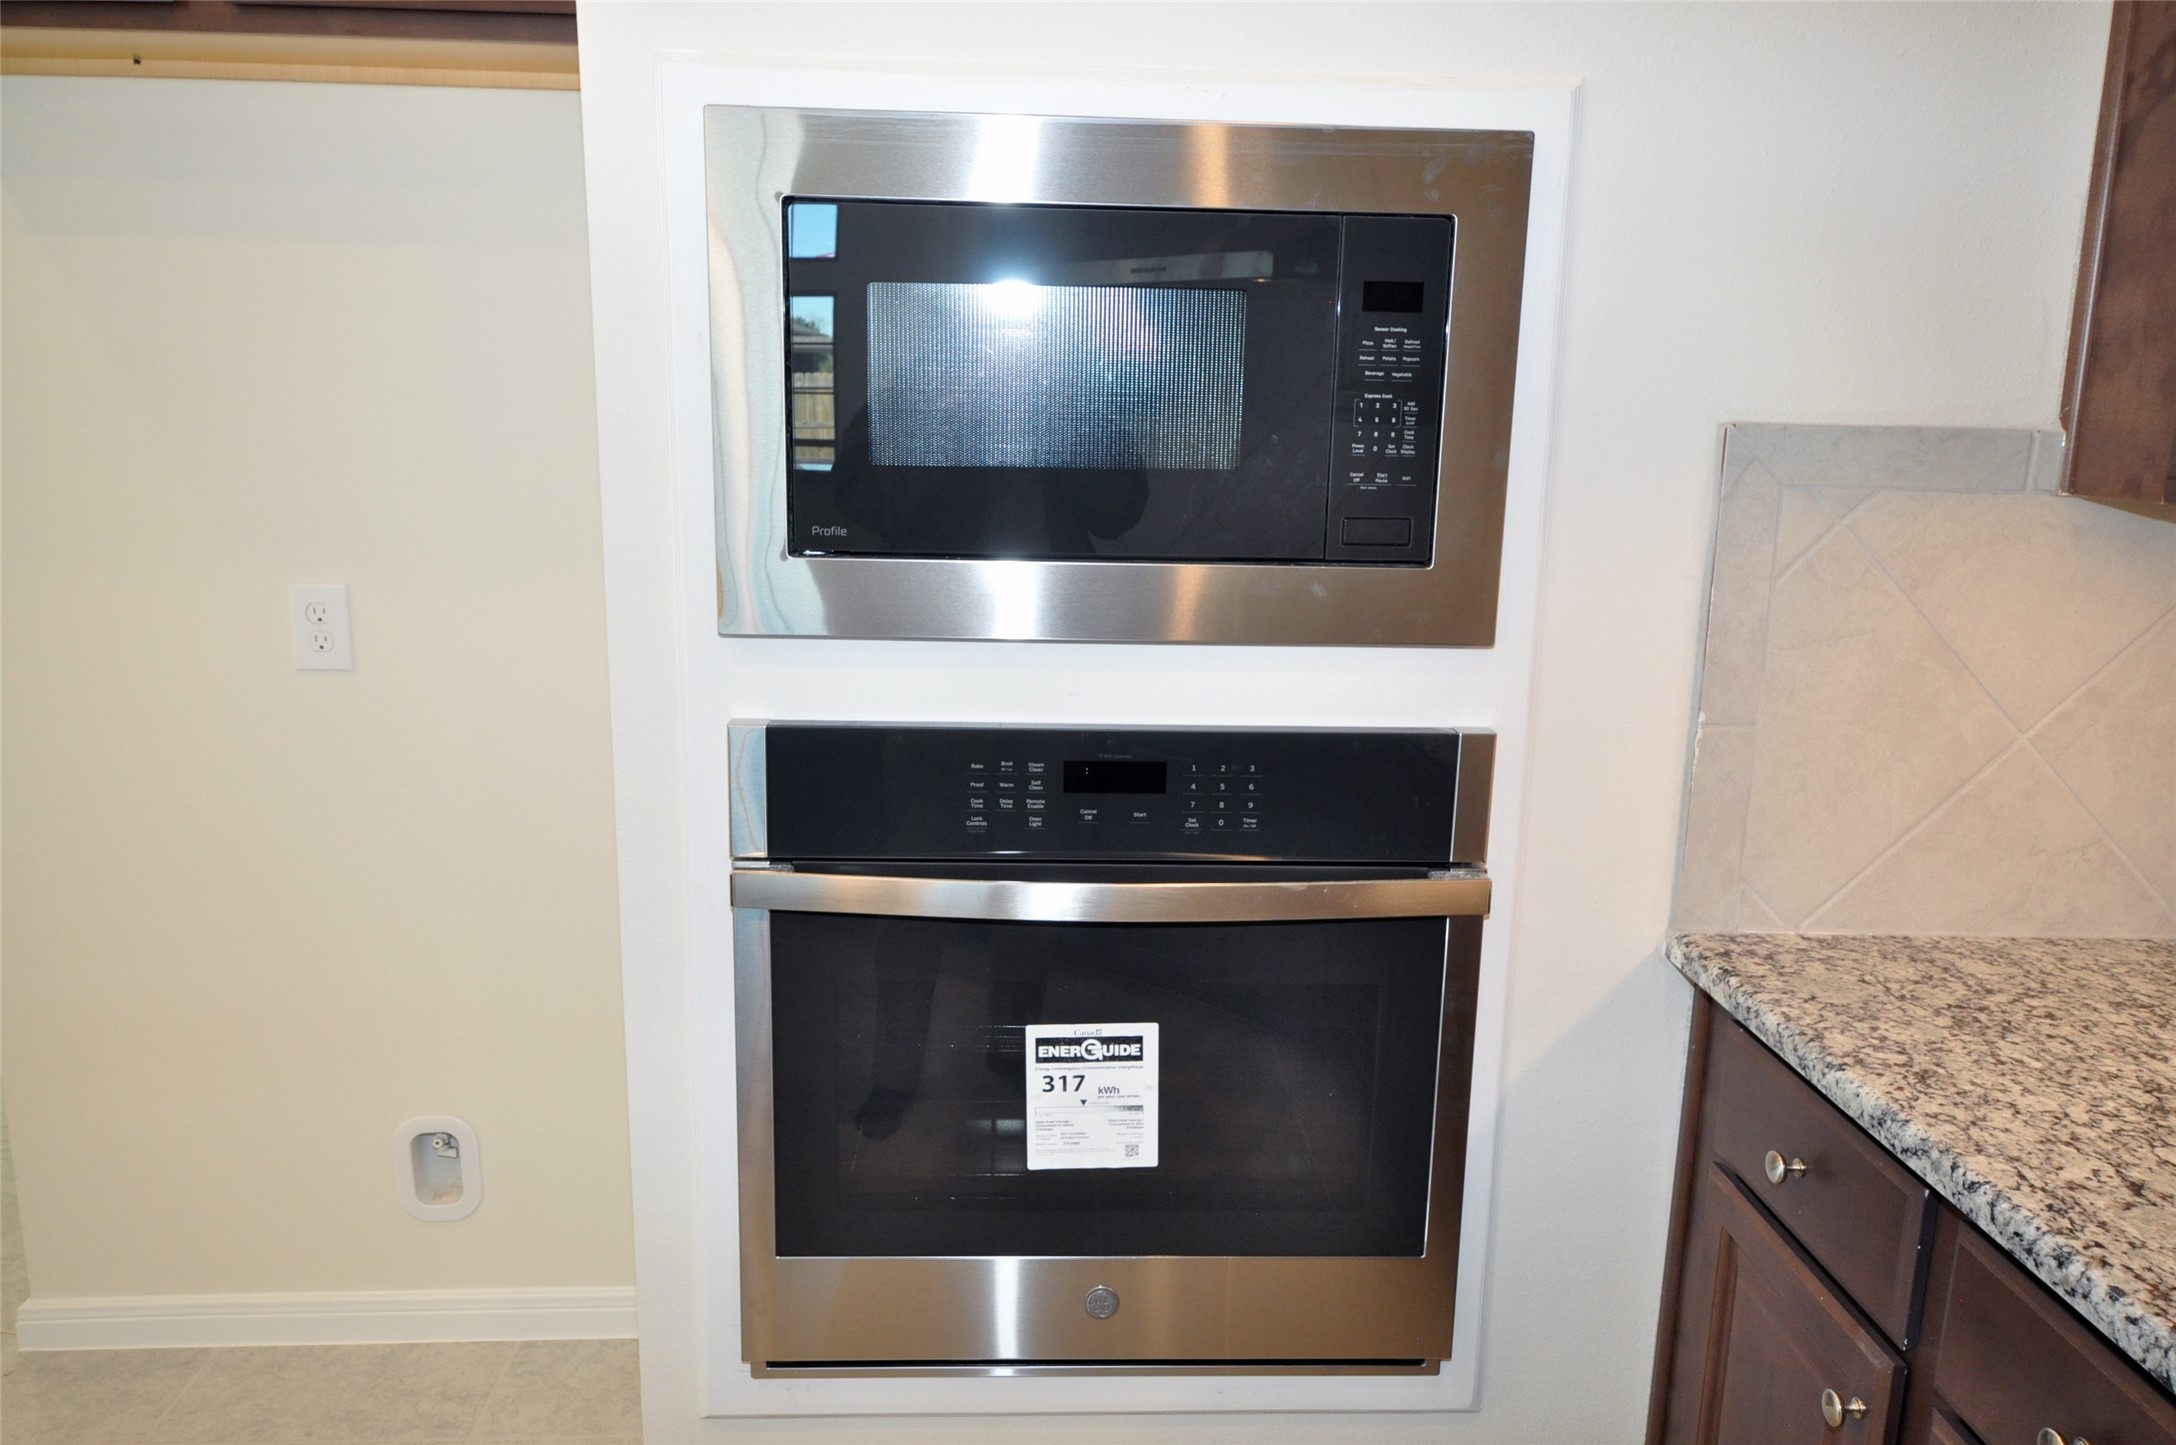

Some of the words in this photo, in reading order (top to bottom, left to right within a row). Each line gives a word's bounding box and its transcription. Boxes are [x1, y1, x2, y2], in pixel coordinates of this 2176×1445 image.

[812, 526, 847, 536] Profile
[1220, 783, 1225, 791] 5
[1038, 1039, 1141, 1060] ENERGUIDE
[1042, 1075, 1085, 1093] 317
[1098, 1086, 1120, 1095] kWh
